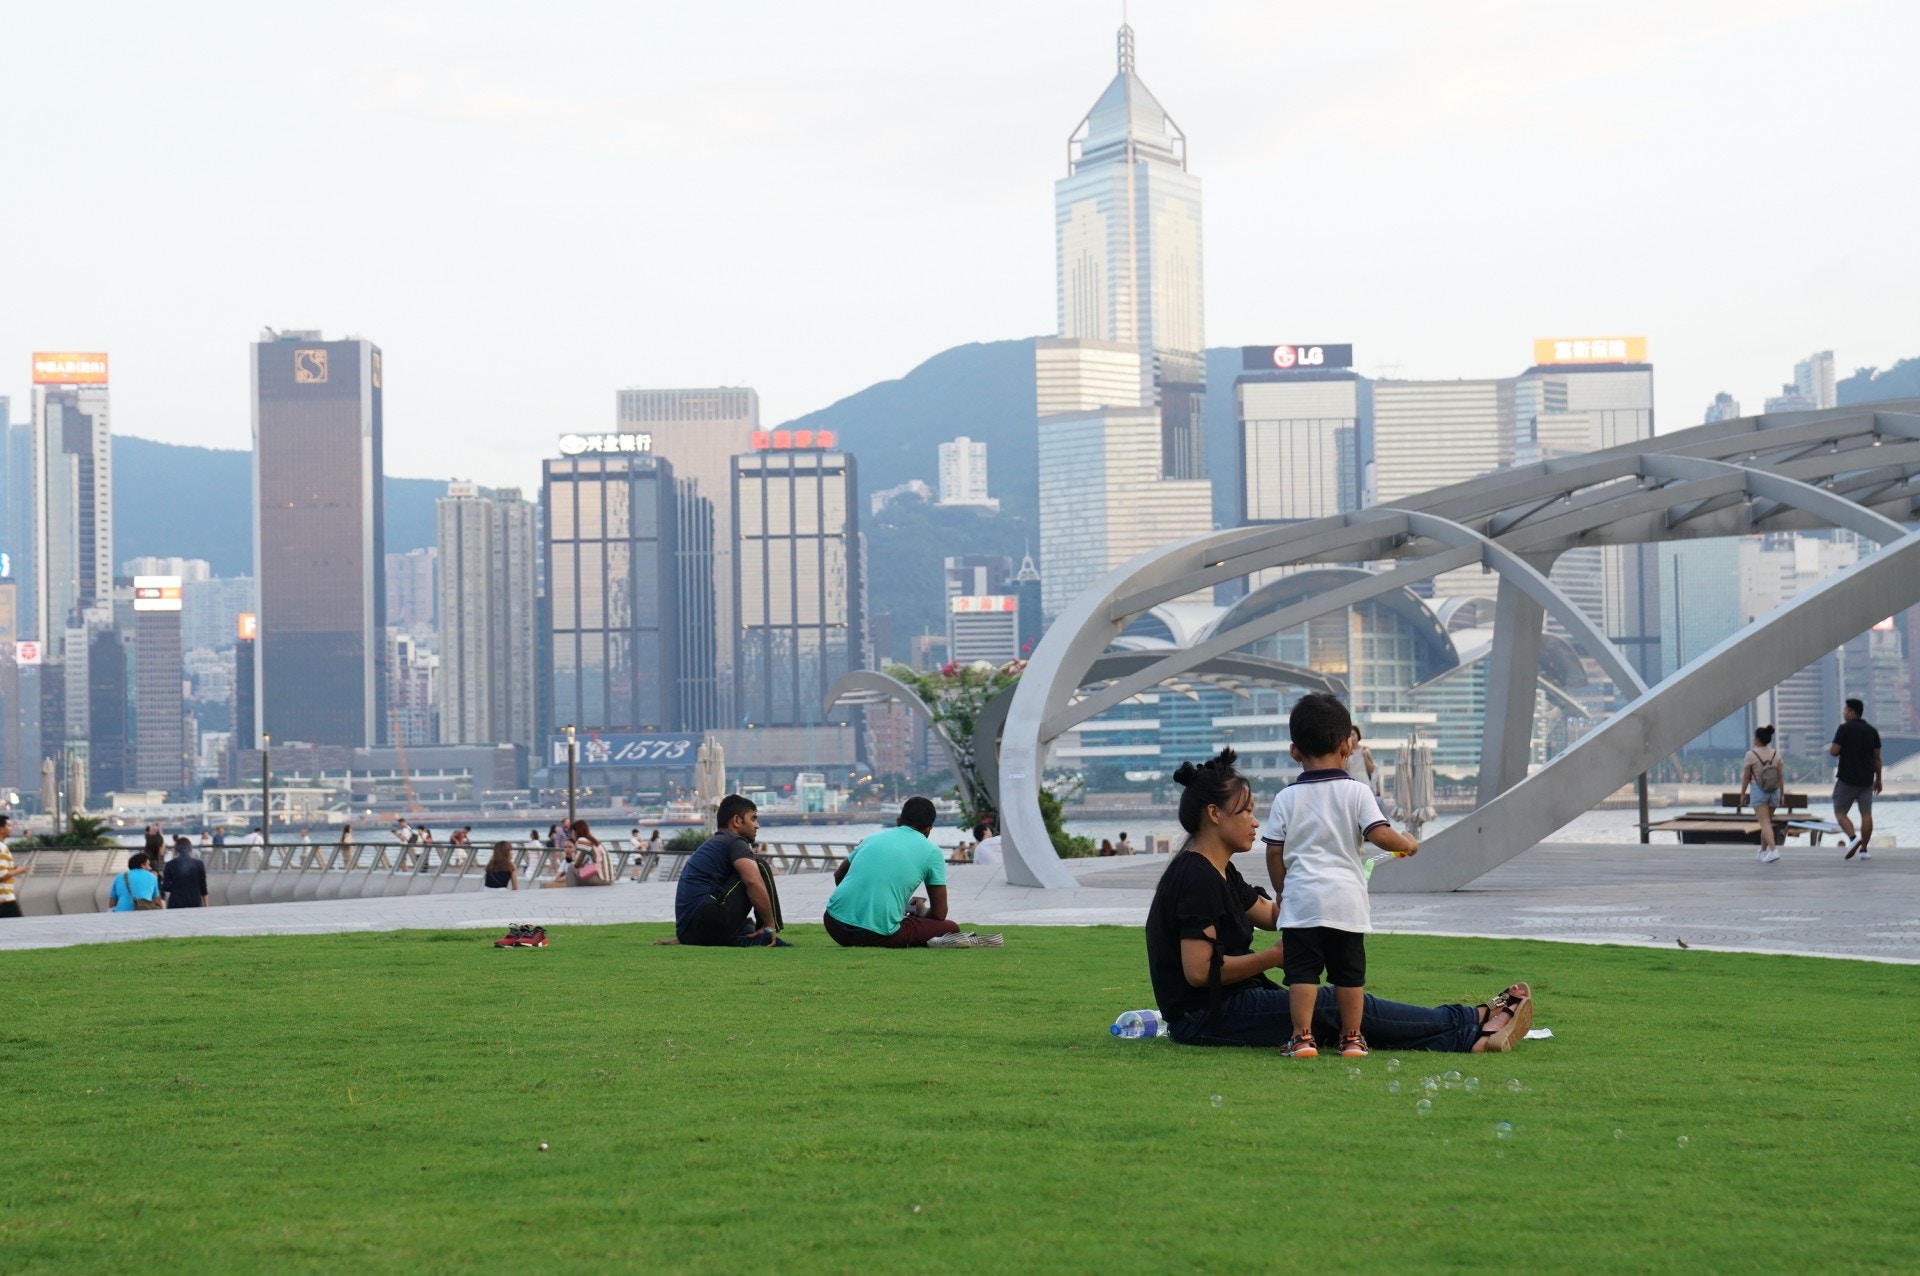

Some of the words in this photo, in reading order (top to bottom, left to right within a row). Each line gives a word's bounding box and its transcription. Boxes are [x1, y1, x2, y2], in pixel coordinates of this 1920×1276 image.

[1297, 346, 1324, 366] LG
[586, 433, 651, 453] 兴业银行
